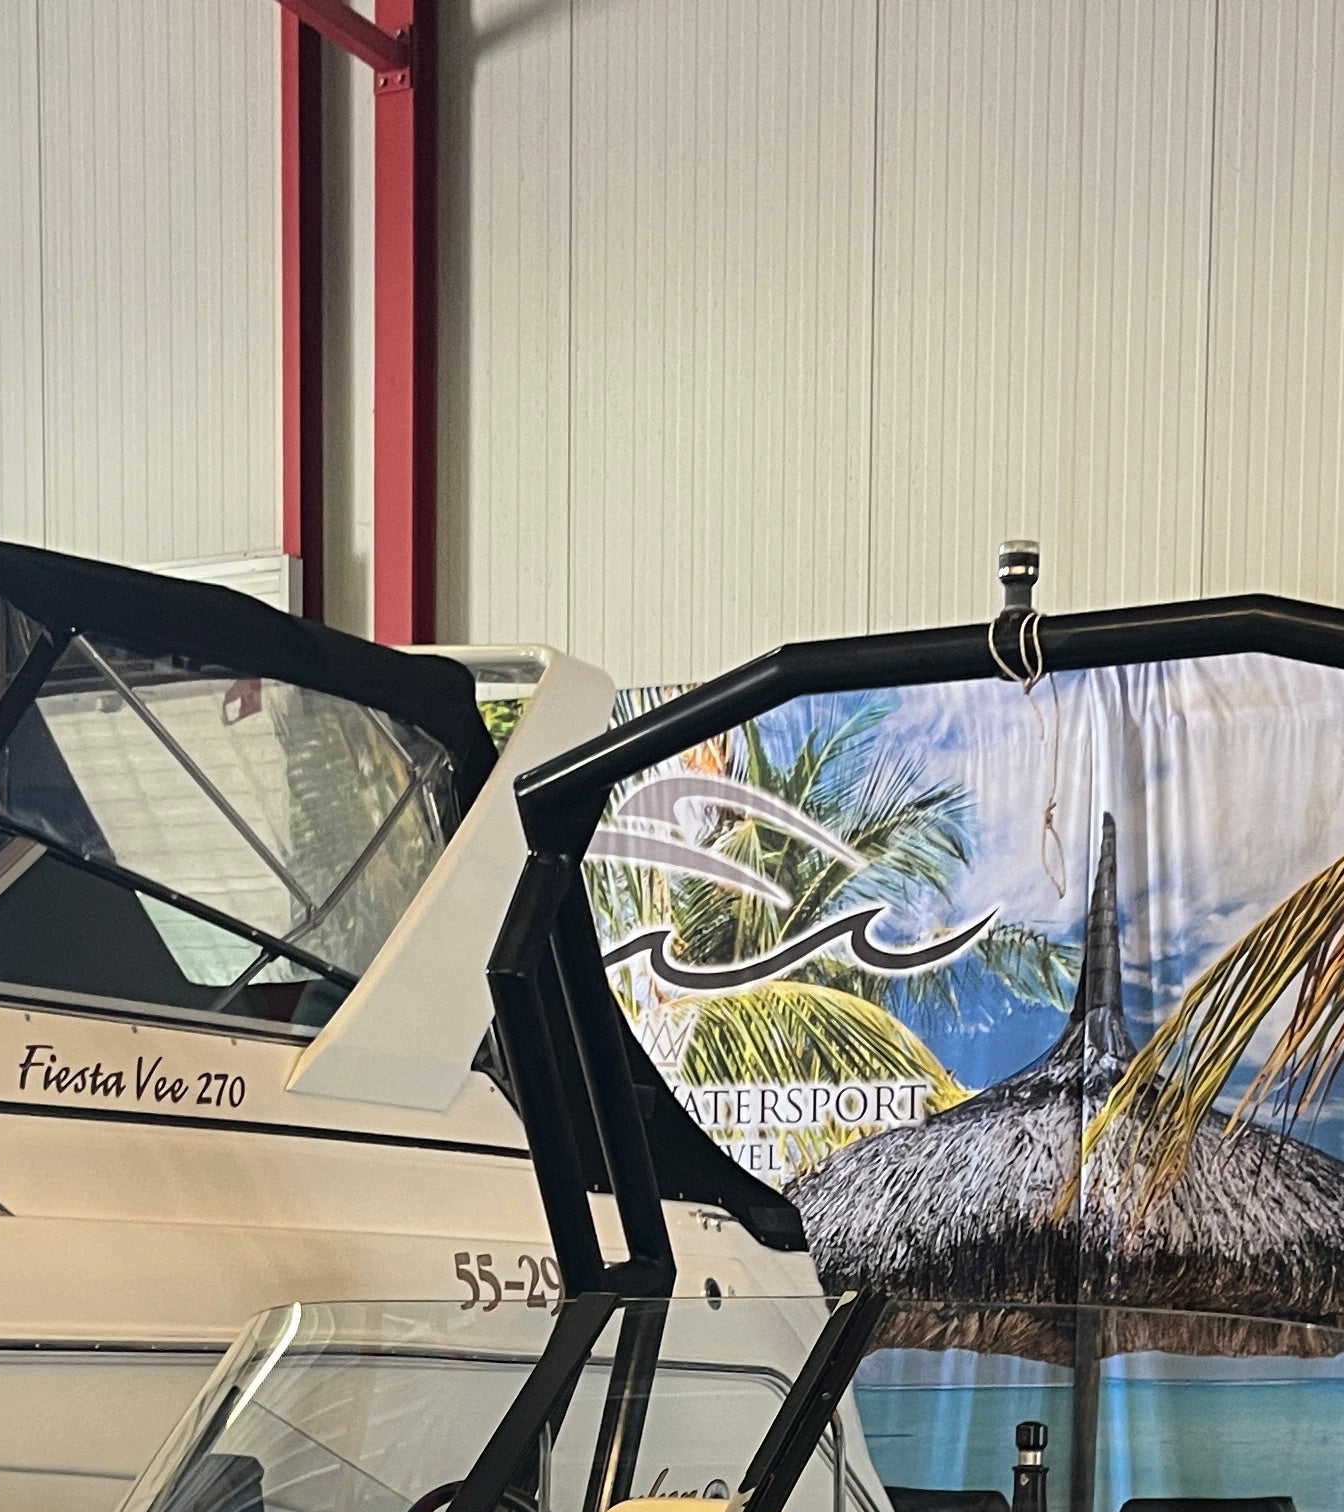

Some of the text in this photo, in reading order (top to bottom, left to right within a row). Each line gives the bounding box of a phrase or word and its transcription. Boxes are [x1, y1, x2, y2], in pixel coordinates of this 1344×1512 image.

[18, 1044, 246, 1109] Fiesta Vee 270
[672, 1084, 928, 1126] ATERSPORT
[718, 1143, 782, 1171] VEL
